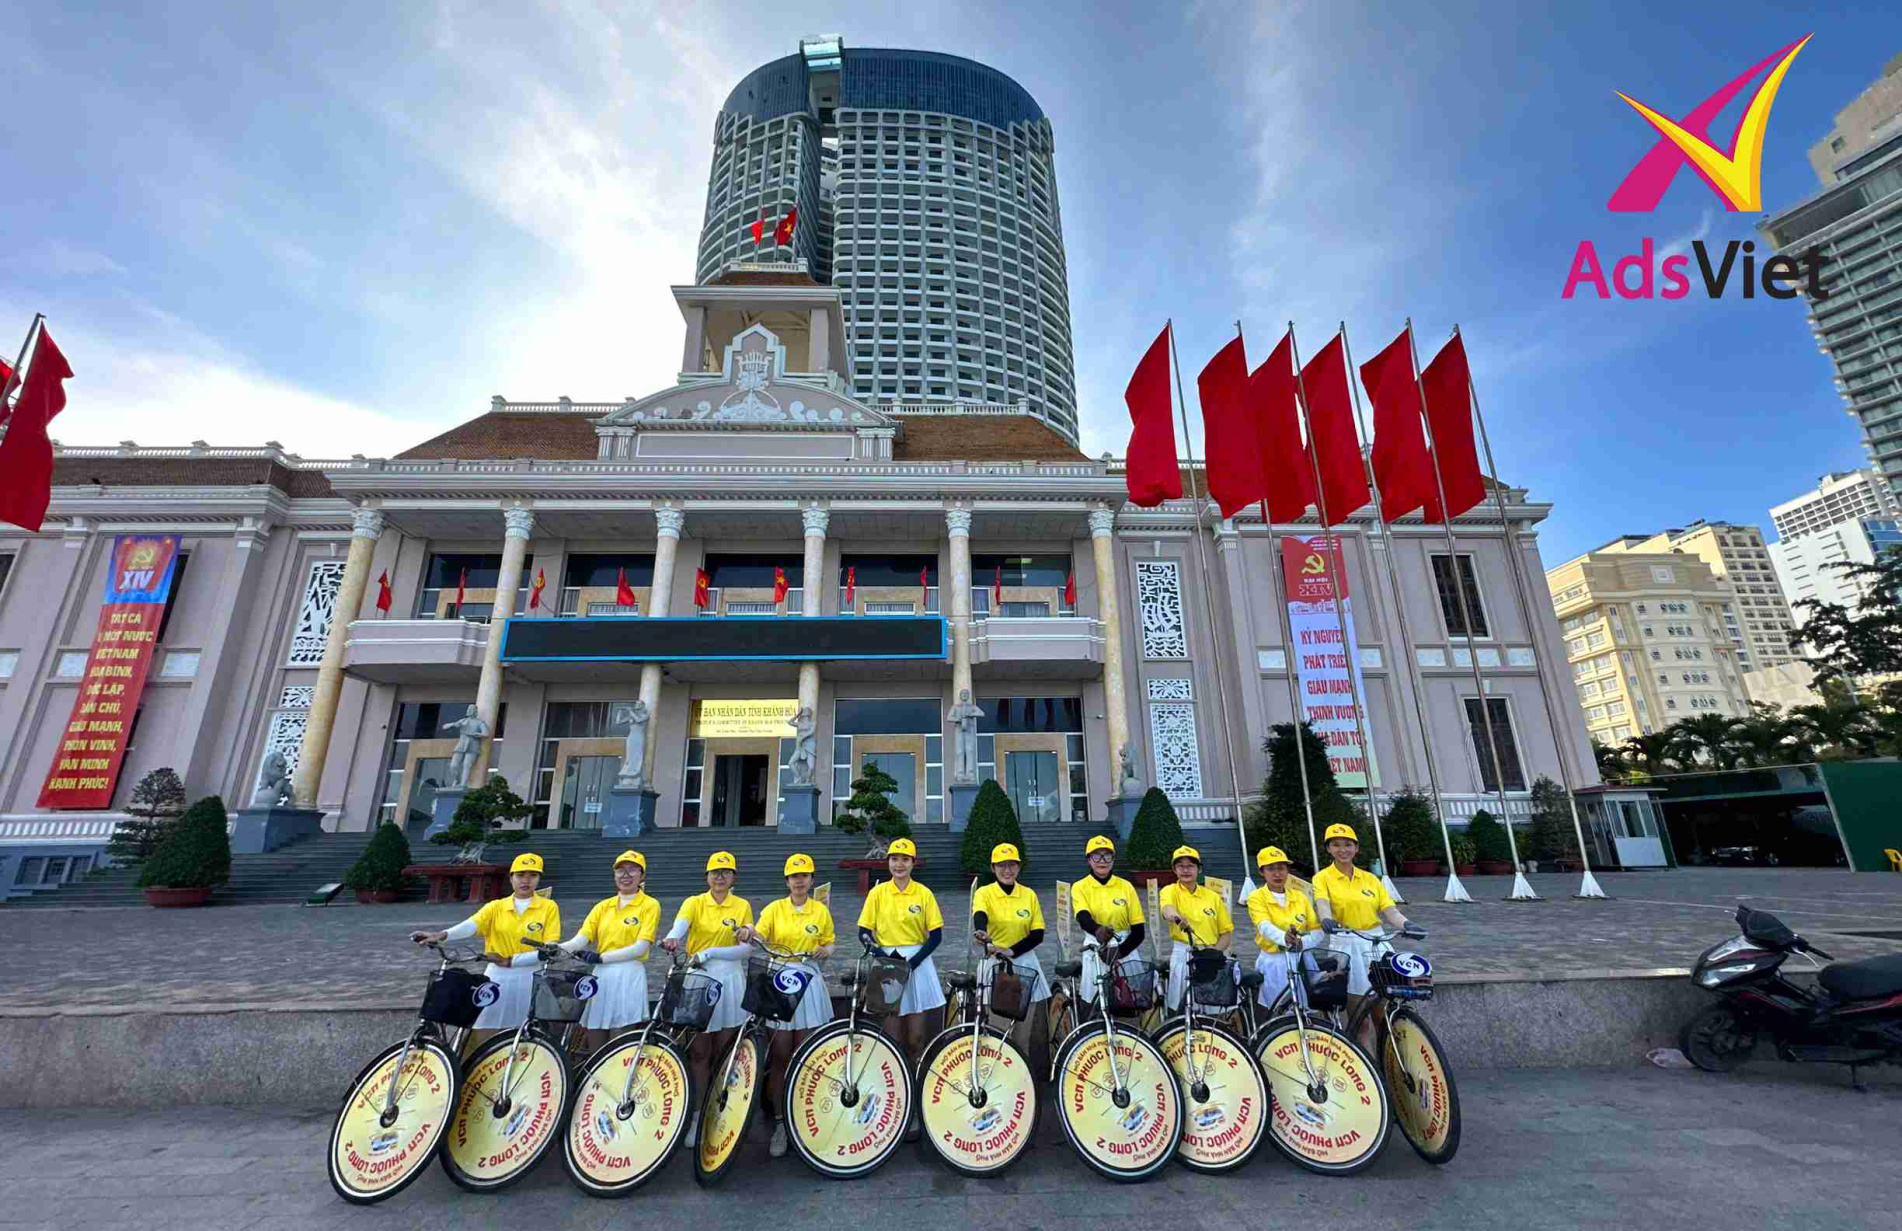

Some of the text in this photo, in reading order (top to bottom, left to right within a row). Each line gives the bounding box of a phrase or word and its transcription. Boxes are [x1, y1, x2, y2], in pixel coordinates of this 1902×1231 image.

[119, 571, 154, 589] XIV
[1399, 959, 1420, 970] VCN
[781, 975, 799, 986] VCN
[519, 1051, 529, 1061] 2
[1198, 1043, 1228, 1061] LONG
[1227, 1056, 1238, 1069] 2
[880, 1060, 894, 1088] VCN
[931, 1075, 945, 1103] VCN
[1002, 1055, 1013, 1068] 2
[1074, 1083, 1084, 1112] VCN
[1134, 1050, 1143, 1063] 2
[1274, 1041, 1299, 1060] VCN
[1340, 1058, 1366, 1091] LONG
[1360, 1096, 1370, 1105] 2
[430, 1082, 440, 1095] 2
[540, 1070, 550, 1099] VCN
[591, 1078, 602, 1091] 2
[805, 1108, 819, 1137] VCN
[853, 1042, 862, 1053] 2
[1012, 1091, 1024, 1119] VCN
[1155, 1082, 1165, 1111] VCN
[581, 1091, 595, 1127] LONG
[660, 1089, 672, 1126] LONG
[1236, 1097, 1250, 1124] VCN
[653, 1128, 665, 1142] 2
[849, 1131, 877, 1153] LONG
[942, 1130, 953, 1141] 2
[952, 1136, 982, 1152] LONG
[1095, 1136, 1105, 1149] 2
[1334, 1129, 1360, 1147] VCN
[343, 1139, 353, 1152] 2
[488, 1142, 519, 1165] LONG
[836, 1144, 845, 1156] 2
[1107, 1141, 1138, 1154] LONG
[475, 1155, 487, 1168] 2
[606, 1155, 630, 1168] VCN
